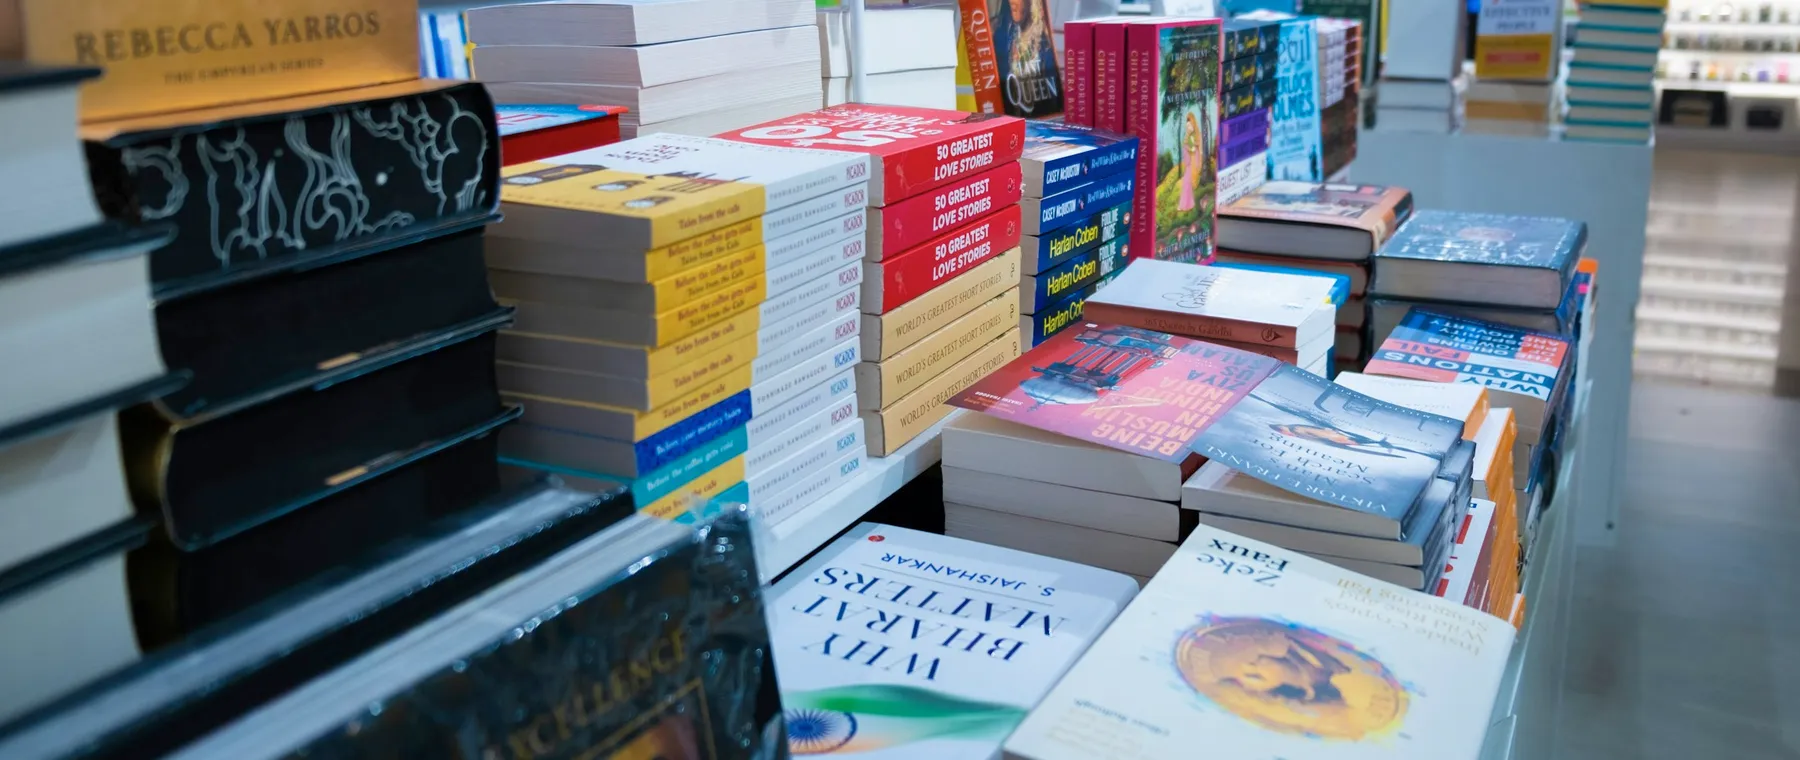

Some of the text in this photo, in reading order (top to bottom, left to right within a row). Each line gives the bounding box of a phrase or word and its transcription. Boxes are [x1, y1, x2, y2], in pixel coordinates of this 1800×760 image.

[73, 10, 381, 65] REBECCA YARROS
[971, 10, 997, 89] QUEEN
[1006, 73, 1058, 113] QUEEN
[1077, 50, 1086, 119] THE FOREST
[1107, 50, 1116, 121] THE FOREST
[1272, 91, 1315, 122] OLMES
[739, 125, 918, 148] 50
[936, 132, 993, 161] 50 GREATEST
[1139, 50, 1149, 234] THE FOREST ENCHANTMENTS
[846, 161, 866, 180] PICADOR
[935, 150, 994, 181] LOVE STORIES
[1046, 168, 1060, 184] CASEY
[935, 178, 990, 211] 50 GREATEST
[933, 196, 991, 231] LOVE STORIES
[1042, 207, 1056, 223] CASEY
[842, 239, 862, 260] PICADOR
[935, 224, 990, 260] 50 GREATEST
[1049, 225, 1099, 258] Harlan Coben
[838, 266, 858, 287] PICADOR
[933, 241, 991, 281] LOVE STORIES
[1047, 275, 1073, 296] Harlan
[1073, 259, 1097, 283] Coben
[835, 291, 856, 312] PICADOR
[896, 271, 1002, 337] WORLD'S GREATEST SHORT STORIES
[1043, 300, 1085, 336] Harlan Cob
[835, 318, 856, 340] PICADOR
[1430, 320, 1515, 340] POVERTY
[834, 347, 856, 368] PICADOR
[896, 313, 1002, 384] WORLD'S GREATEST SHORT STORIES
[1394, 341, 1461, 359] FAIL
[1427, 337, 1509, 356] ORIGINS
[1186, 370, 1247, 391] ZIYA
[1223, 365, 1256, 380] US
[1383, 351, 1546, 384] NATIONS
[830, 377, 849, 396] PICADOR
[900, 401, 930, 428] WORLD'S
[931, 378, 962, 411] GREATEST
[962, 365, 983, 389] SHORT
[982, 351, 1005, 375] STORIES
[1159, 376, 1235, 404] INDIA
[1460, 376, 1541, 396] WHY
[831, 403, 853, 426] PICADOR
[1079, 404, 1197, 443] MUSLIM
[1176, 410, 1210, 429] IN
[837, 432, 856, 452] PICADOR
[1090, 423, 1182, 457] BEING
[1269, 433, 1369, 473] Meaning
[840, 457, 859, 477] PICADOR
[1207, 446, 1280, 481] FRANKL
[1249, 440, 1374, 484] Search For
[1306, 485, 1387, 512] VIKTOR
[880, 552, 1025, 589] JAISHANKAR
[1196, 553, 1281, 588] Zeke
[1208, 537, 1288, 573] Faux
[814, 566, 1070, 637] MATTERS
[792, 595, 1029, 662] BHARAT
[801, 633, 942, 681] WHY
